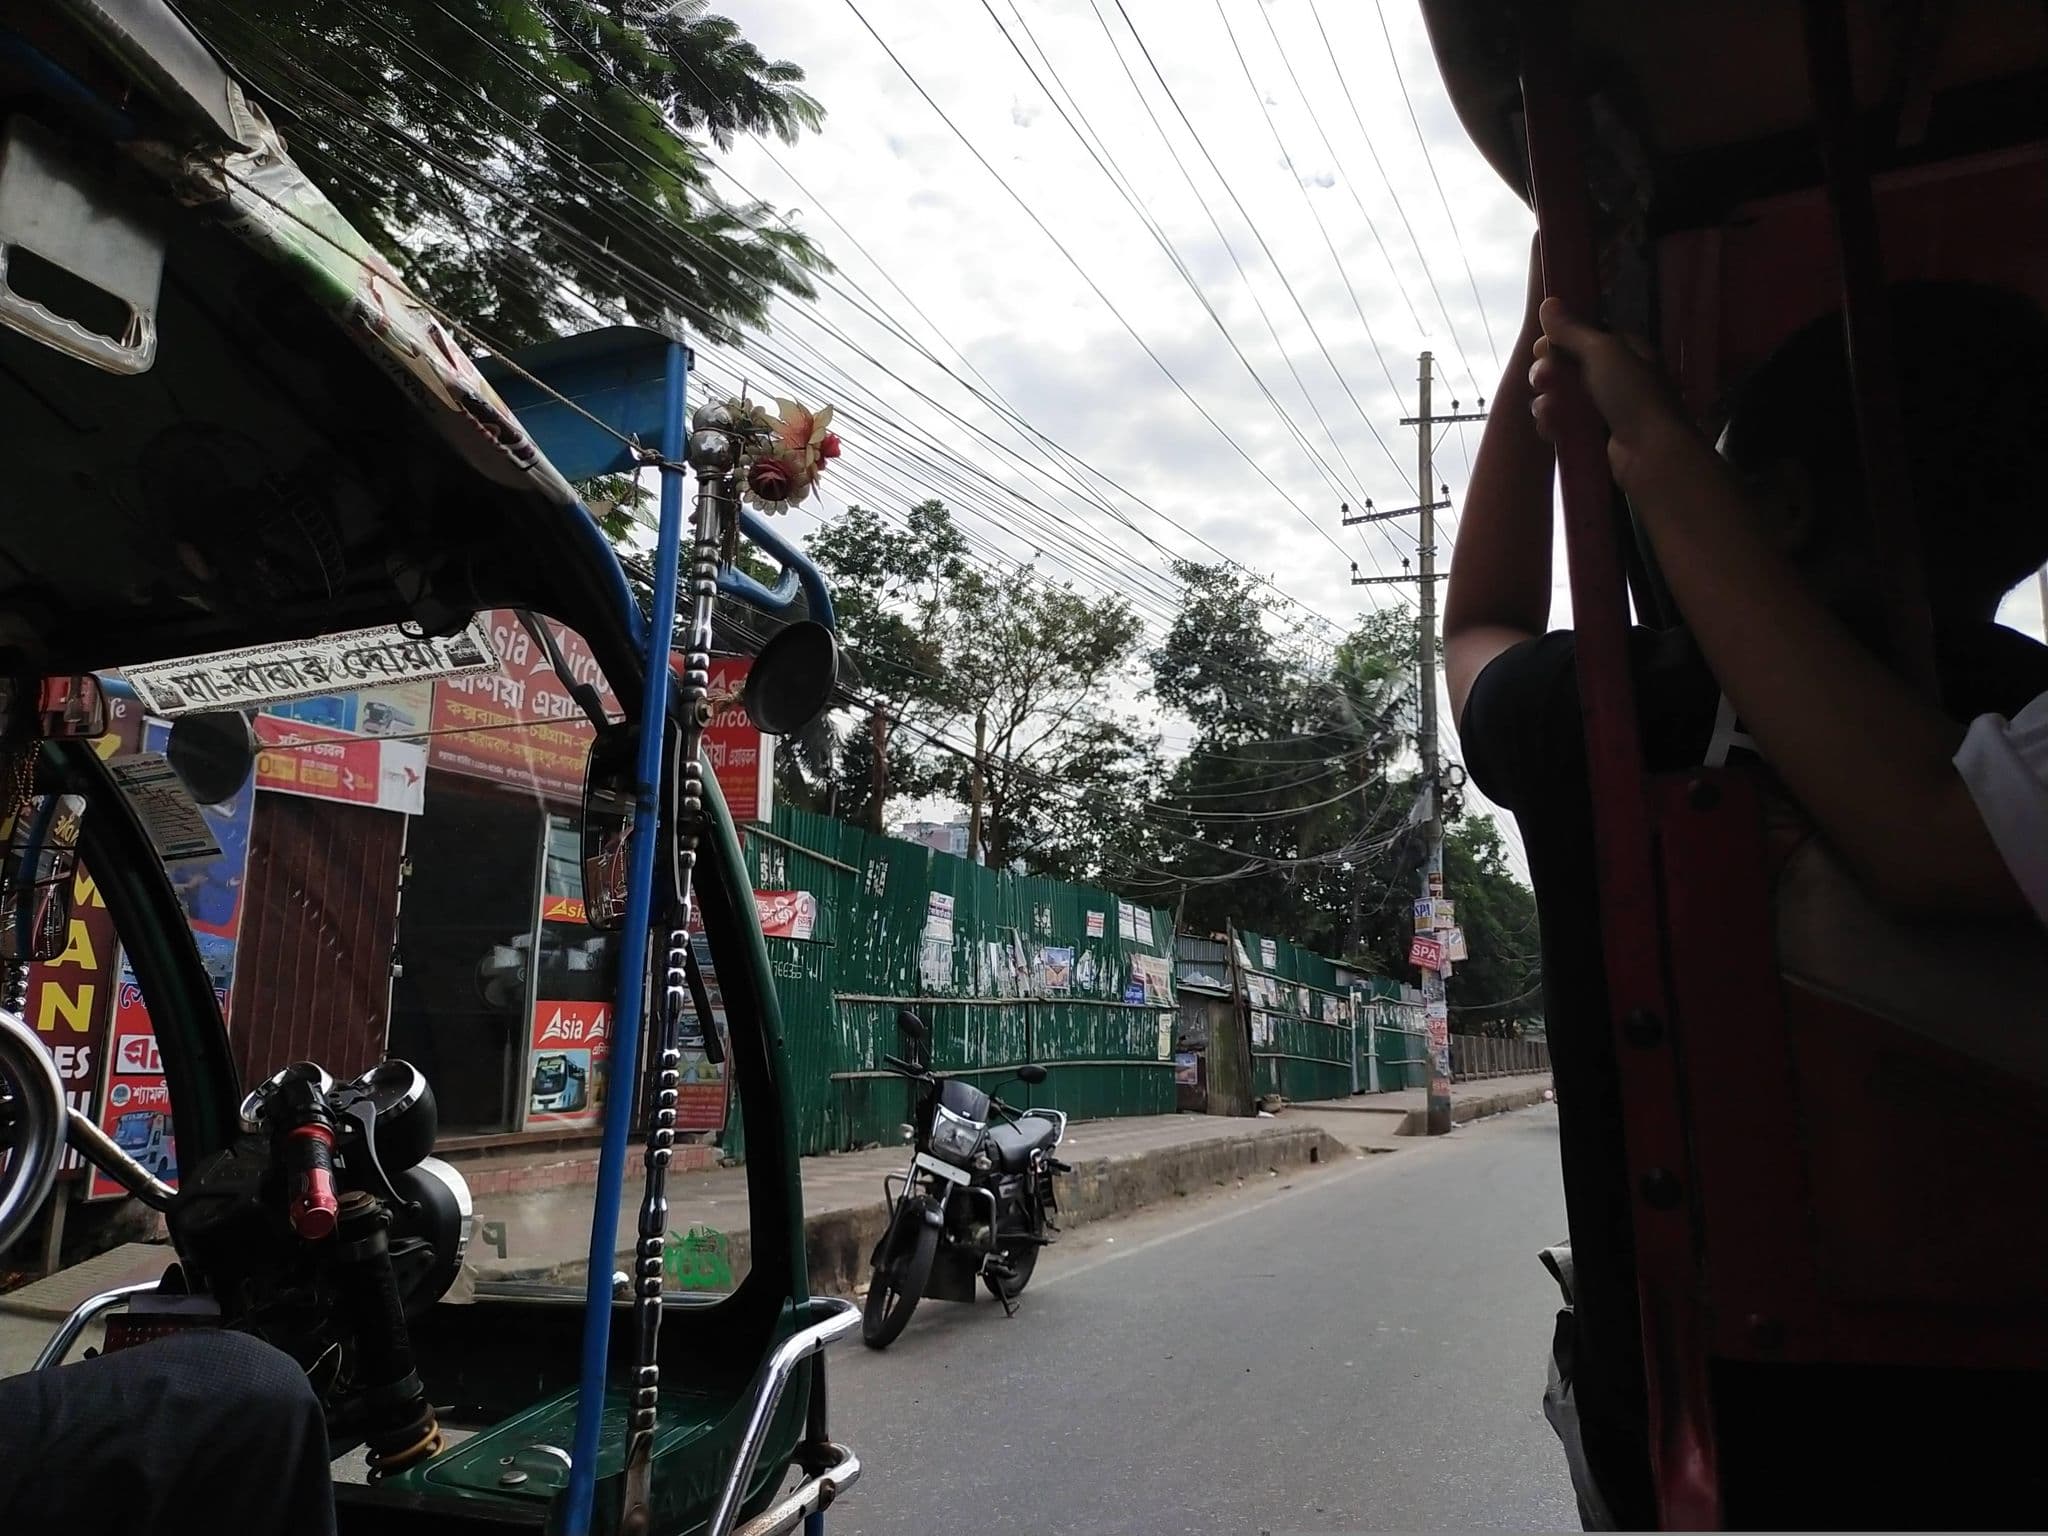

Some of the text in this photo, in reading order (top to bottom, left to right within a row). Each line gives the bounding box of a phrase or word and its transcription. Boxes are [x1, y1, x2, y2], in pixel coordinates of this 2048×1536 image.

[1414, 903, 1431, 919] SPA
[1411, 943, 1438, 962] SPA
[538, 1007, 583, 1044] Asia
[47, 1044, 91, 1079] ES
